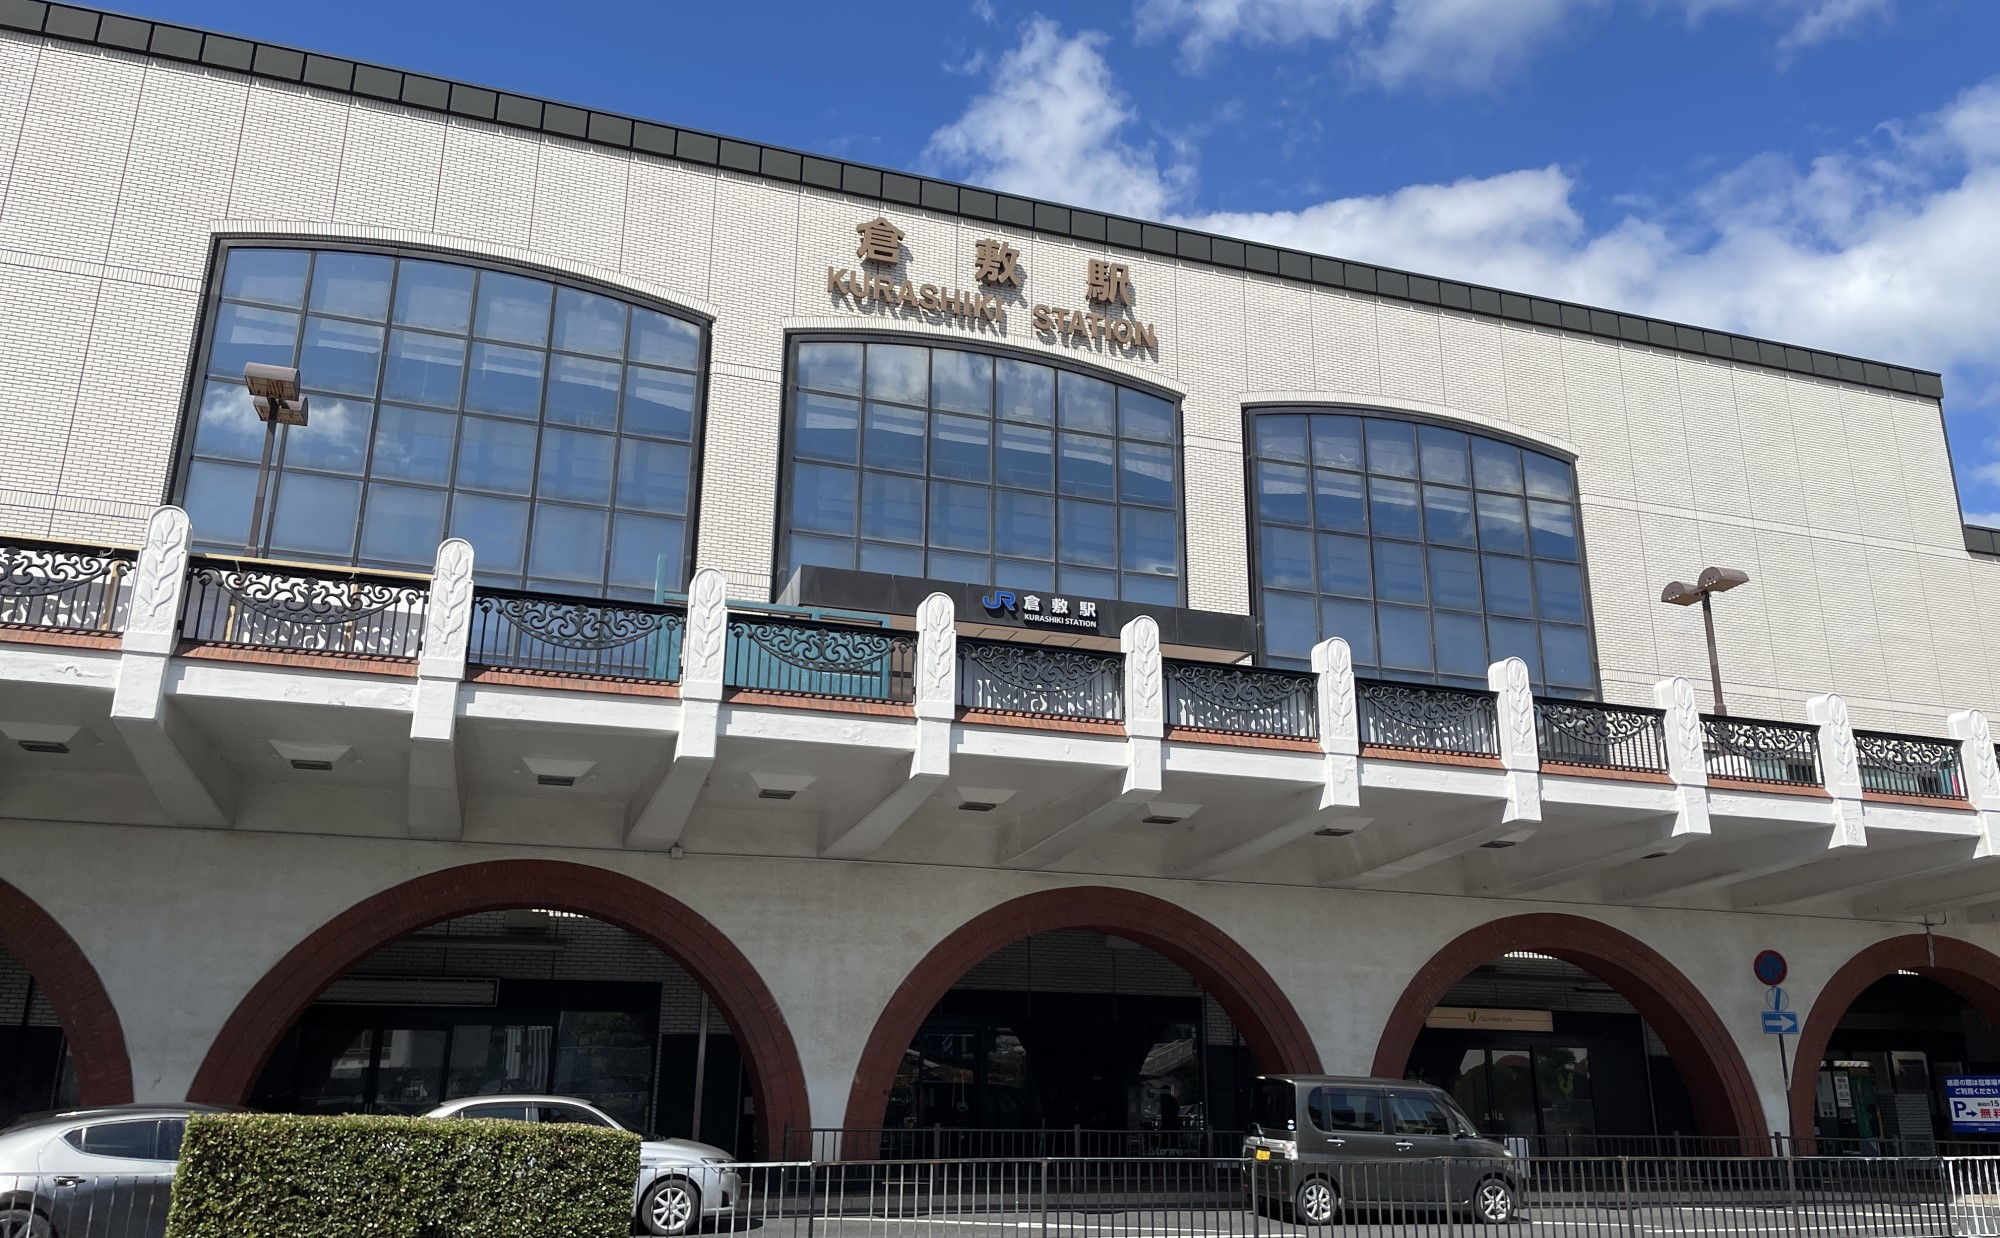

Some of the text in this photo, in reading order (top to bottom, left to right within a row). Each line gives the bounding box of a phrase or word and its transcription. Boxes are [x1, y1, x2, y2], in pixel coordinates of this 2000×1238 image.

[856, 217, 1132, 306] 倉敷駅
[827, 266, 1155, 348] KURASHIKI STATION
[982, 590, 1016, 611] JR
[1023, 595, 1096, 618] 倉敷駅
[1024, 613, 1097, 628] KURASHIKI STATION
[1953, 1101, 1967, 1118] P
